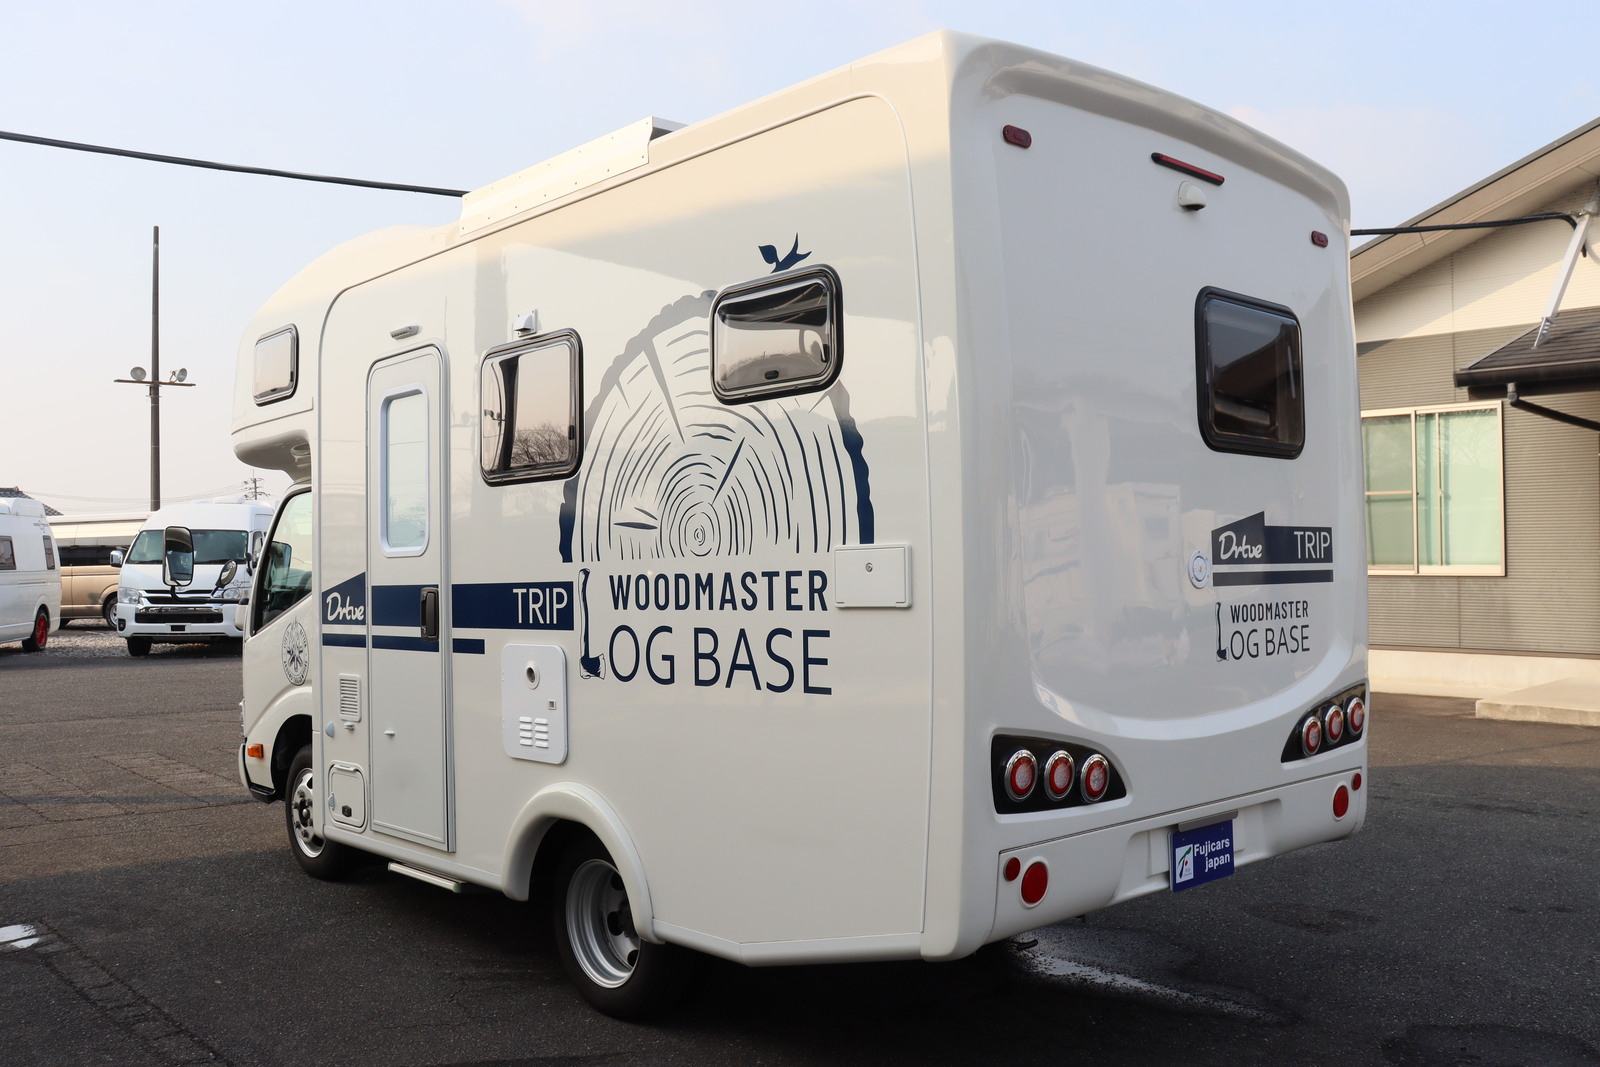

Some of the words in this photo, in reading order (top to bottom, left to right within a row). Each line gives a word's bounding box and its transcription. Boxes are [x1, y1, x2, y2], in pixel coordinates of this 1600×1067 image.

[1218, 530, 1263, 560] Drive
[1293, 531, 1331, 559] TRIP
[326, 592, 365, 621] Drive
[512, 587, 568, 625] TRIP
[609, 569, 829, 612] WOODMASTER
[1230, 600, 1309, 624] WOODMASTER
[1265, 624, 1310, 656] BASE
[693, 627, 832, 695] BASE
[1193, 838, 1230, 857] Fujicars
[1204, 853, 1231, 873] japan
